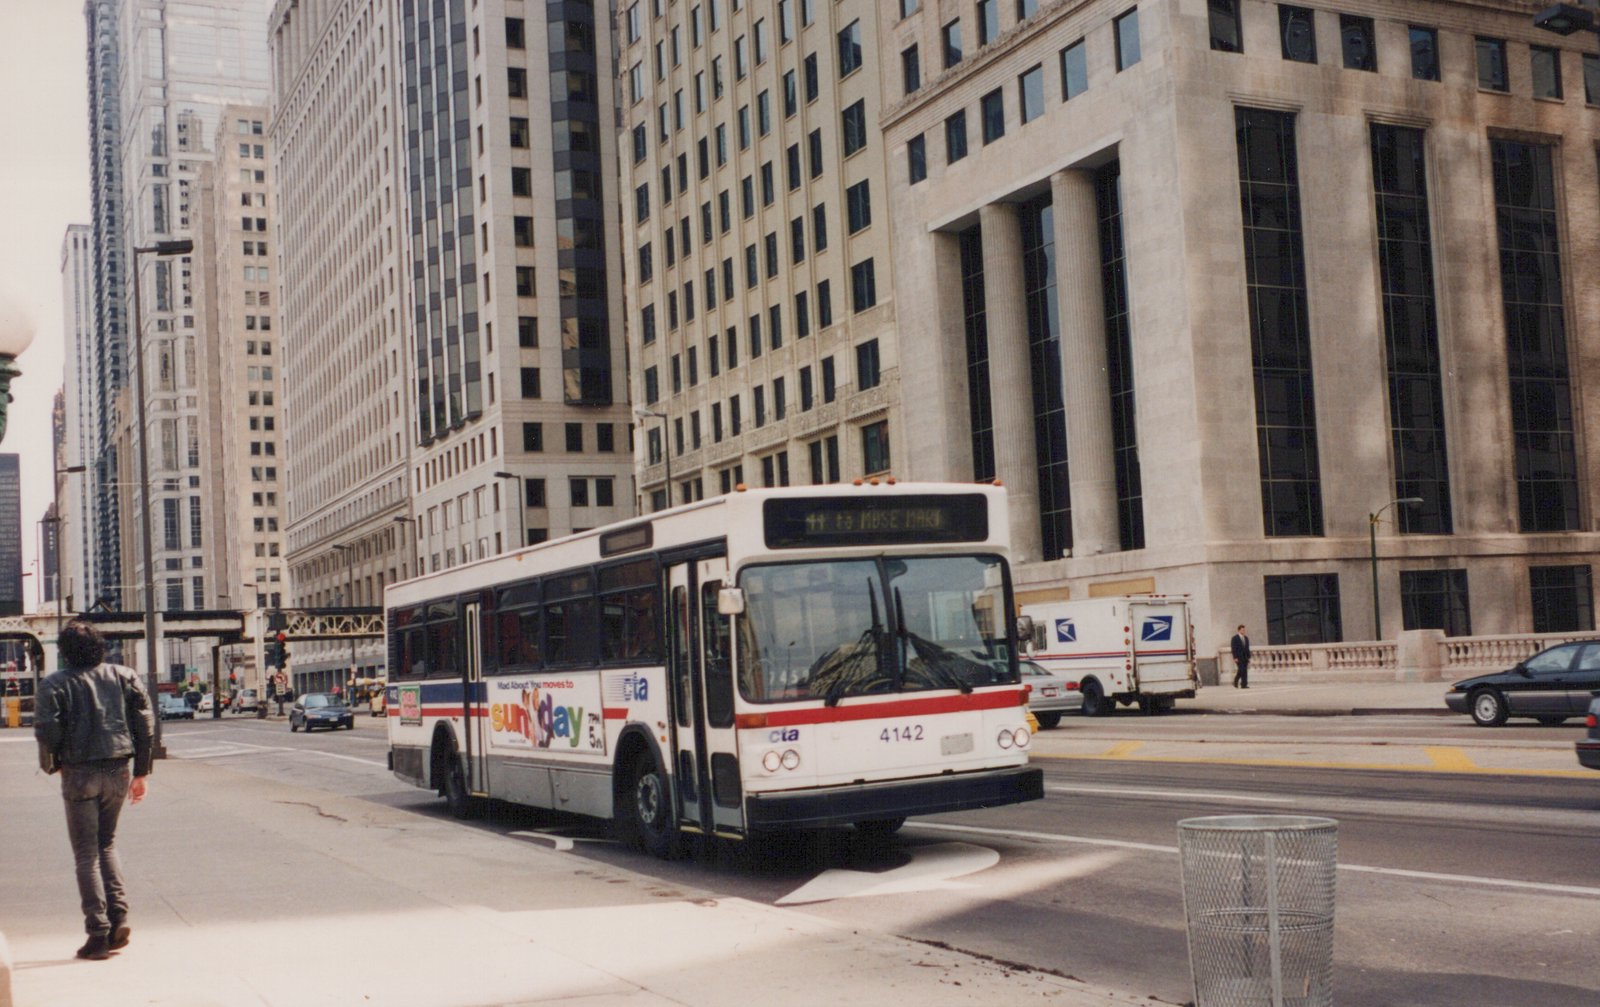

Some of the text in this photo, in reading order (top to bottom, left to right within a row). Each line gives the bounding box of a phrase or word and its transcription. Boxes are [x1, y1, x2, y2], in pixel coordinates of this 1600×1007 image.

[511, 681, 529, 689] About
[542, 680, 565, 689] moves
[566, 679, 574, 688] to
[769, 728, 800, 743] cta
[880, 724, 924, 743] 4142
